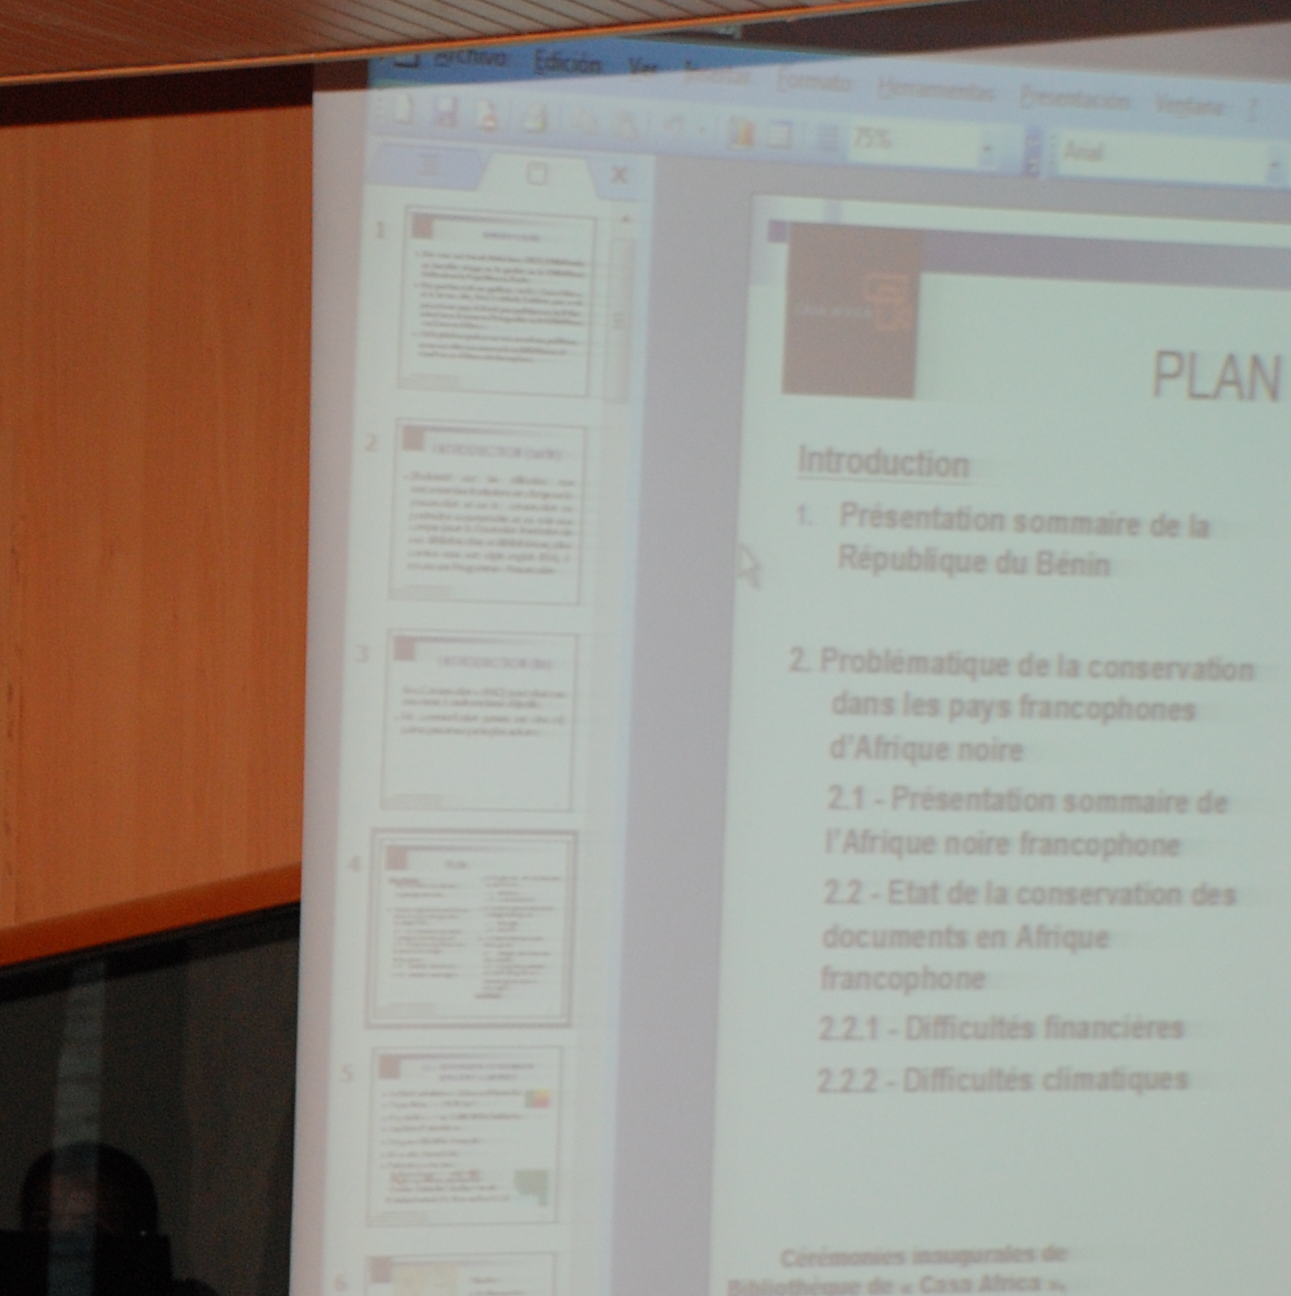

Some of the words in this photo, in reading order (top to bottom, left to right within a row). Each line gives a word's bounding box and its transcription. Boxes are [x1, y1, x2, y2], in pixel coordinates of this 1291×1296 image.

[1152, 348, 1283, 402] PLAN
[796, 444, 973, 480] Introduction
[839, 499, 1006, 534] Présentation
[1014, 510, 1141, 538] sommaire
[1150, 512, 1182, 539] de
[1188, 512, 1214, 540] la
[837, 541, 988, 579] République
[995, 546, 1028, 576] du
[1036, 548, 1113, 579] Bénin
[821, 646, 1011, 682] Problématique
[1019, 651, 1050, 677] de
[1057, 651, 1081, 679] la
[1087, 655, 1257, 682] conservation
[830, 689, 896, 717] dans
[902, 690, 941, 717] les
[948, 696, 1012, 724] pays
[1019, 693, 1198, 726] francophones
[829, 733, 950, 767] d'Afrique
[958, 737, 1025, 762] noire
[827, 784, 866, 811] 2.1
[890, 784, 1056, 813] Présentation
[1063, 789, 1190, 815] sommaire
[1196, 788, 1230, 815] de
[825, 827, 937, 860] l'Afrique
[944, 830, 1012, 856] noire
[1019, 829, 1183, 863] francophone
[823, 879, 863, 905] 2.2
[887, 879, 942, 906] Etat
[948, 879, 979, 906] de
[985, 879, 1009, 906] la
[1017, 880, 1183, 908] conservation
[821, 923, 969, 951] documents
[976, 928, 1007, 951] en
[1014, 923, 1113, 957] Afrique
[820, 964, 989, 997] francophone
[818, 1014, 881, 1042] 2.2.1
[905, 1014, 1036, 1041] Difficultés
[1043, 1013, 1186, 1041] financières
[816, 1067, 881, 1095] 2.2.2
[902, 1067, 1034, 1094] Difficultés
[1042, 1066, 1191, 1098] climatiques
[1041, 1244, 1068, 1264] de
[867, 1275, 896, 1296] de
